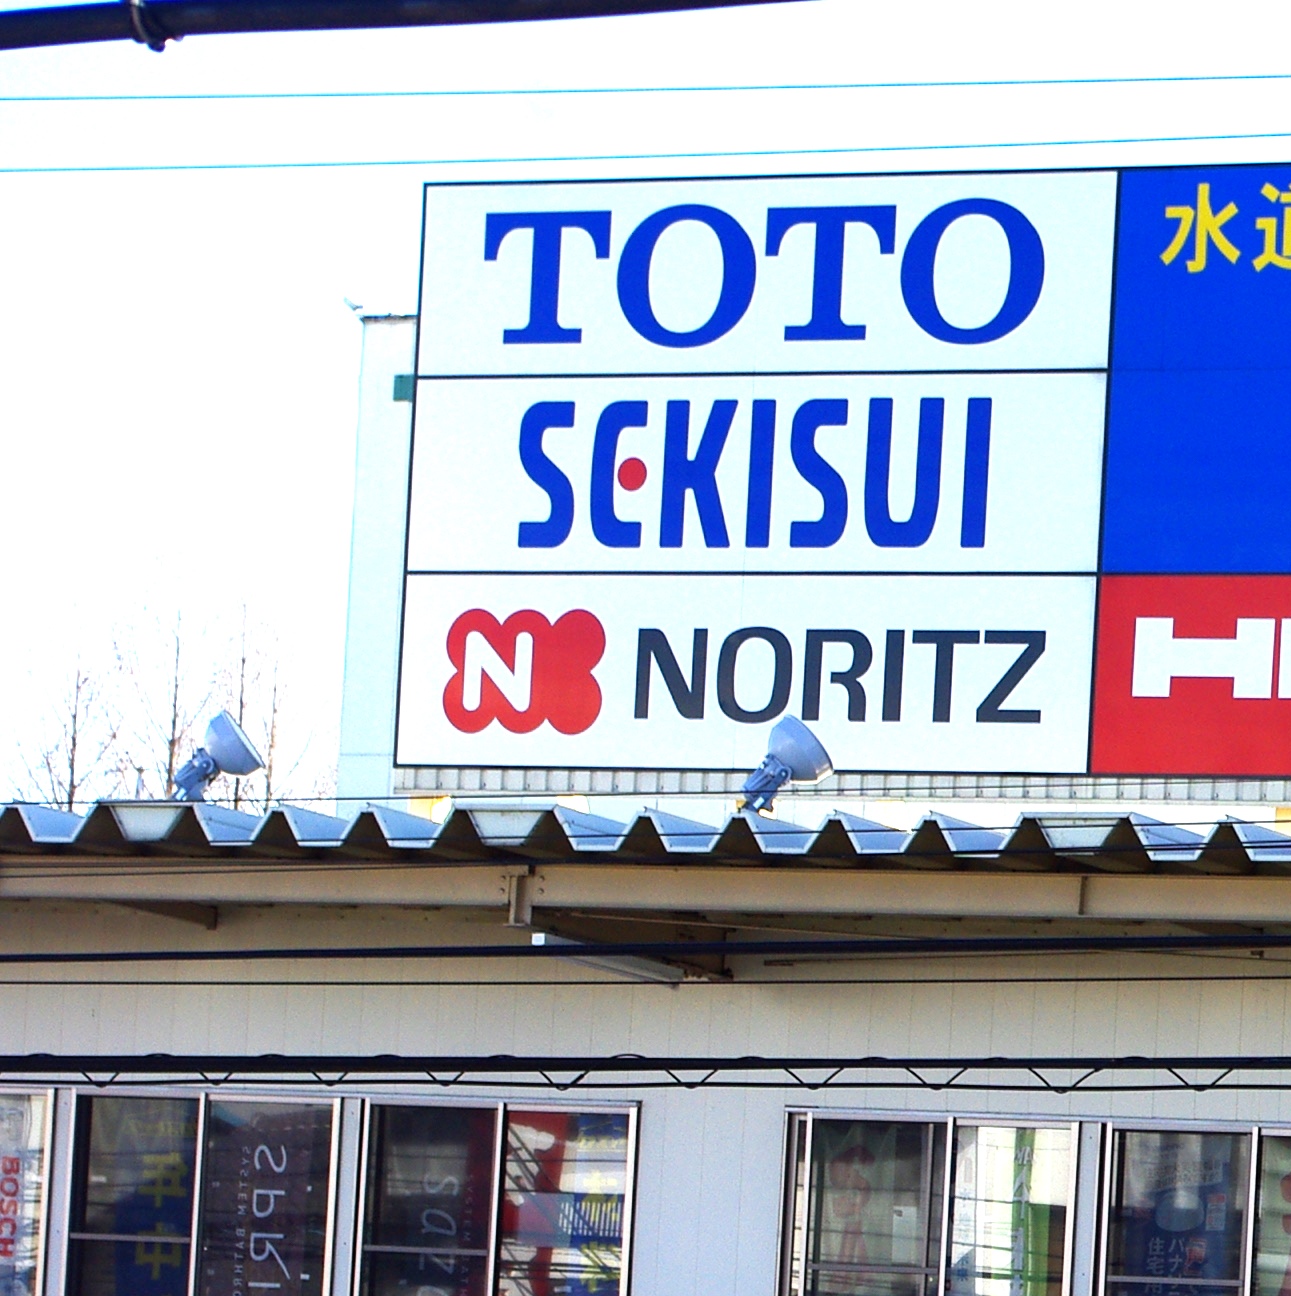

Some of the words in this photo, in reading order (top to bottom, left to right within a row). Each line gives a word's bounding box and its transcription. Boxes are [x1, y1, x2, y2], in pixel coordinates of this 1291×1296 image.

[484, 196, 1045, 349] TOTO
[517, 397, 993, 549] SEKISUI
[633, 626, 1047, 724] NORITZ
